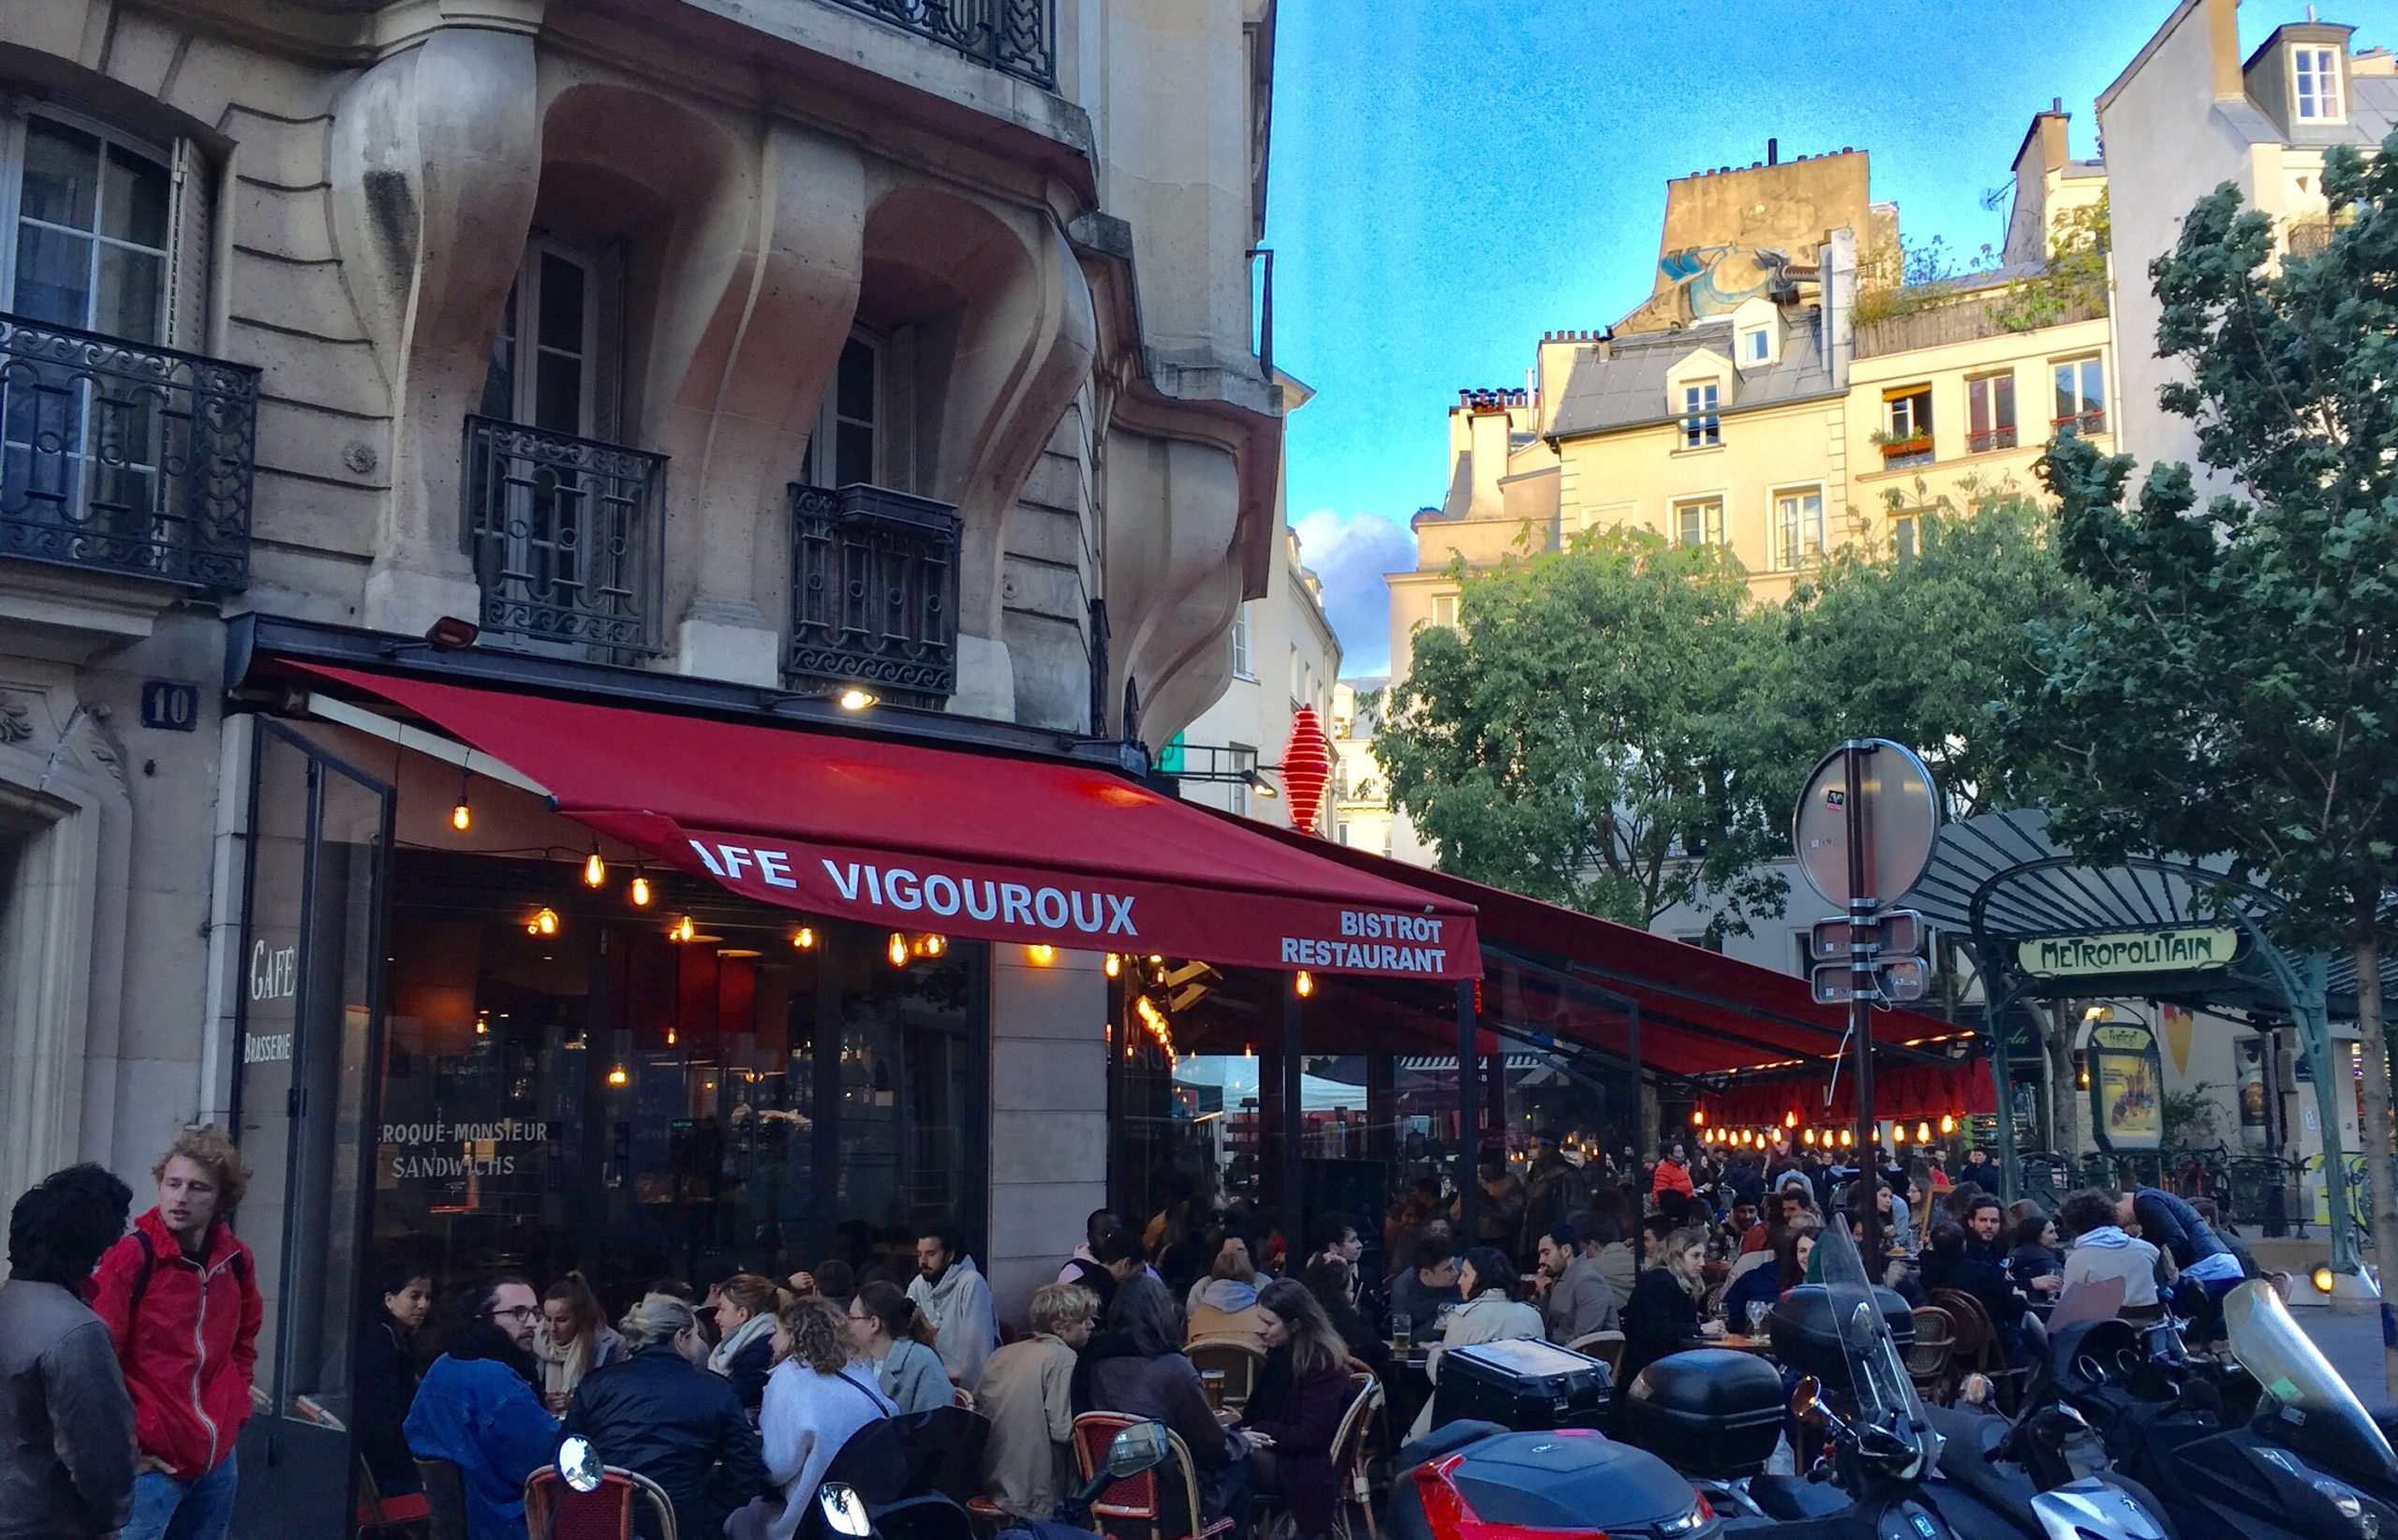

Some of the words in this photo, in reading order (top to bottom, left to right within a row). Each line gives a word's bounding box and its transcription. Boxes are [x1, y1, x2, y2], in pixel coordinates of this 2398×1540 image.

[153, 687, 189, 724] 10
[822, 859, 1139, 936] VIGOUROUX
[1340, 911, 1443, 944] BISTROT
[1280, 937, 1446, 973] RESTAURANT
[2040, 932, 2213, 970] METROPOLITAIN
[244, 1032, 291, 1064] BRASSERIE
[392, 1156, 515, 1178] SANDWICHS
